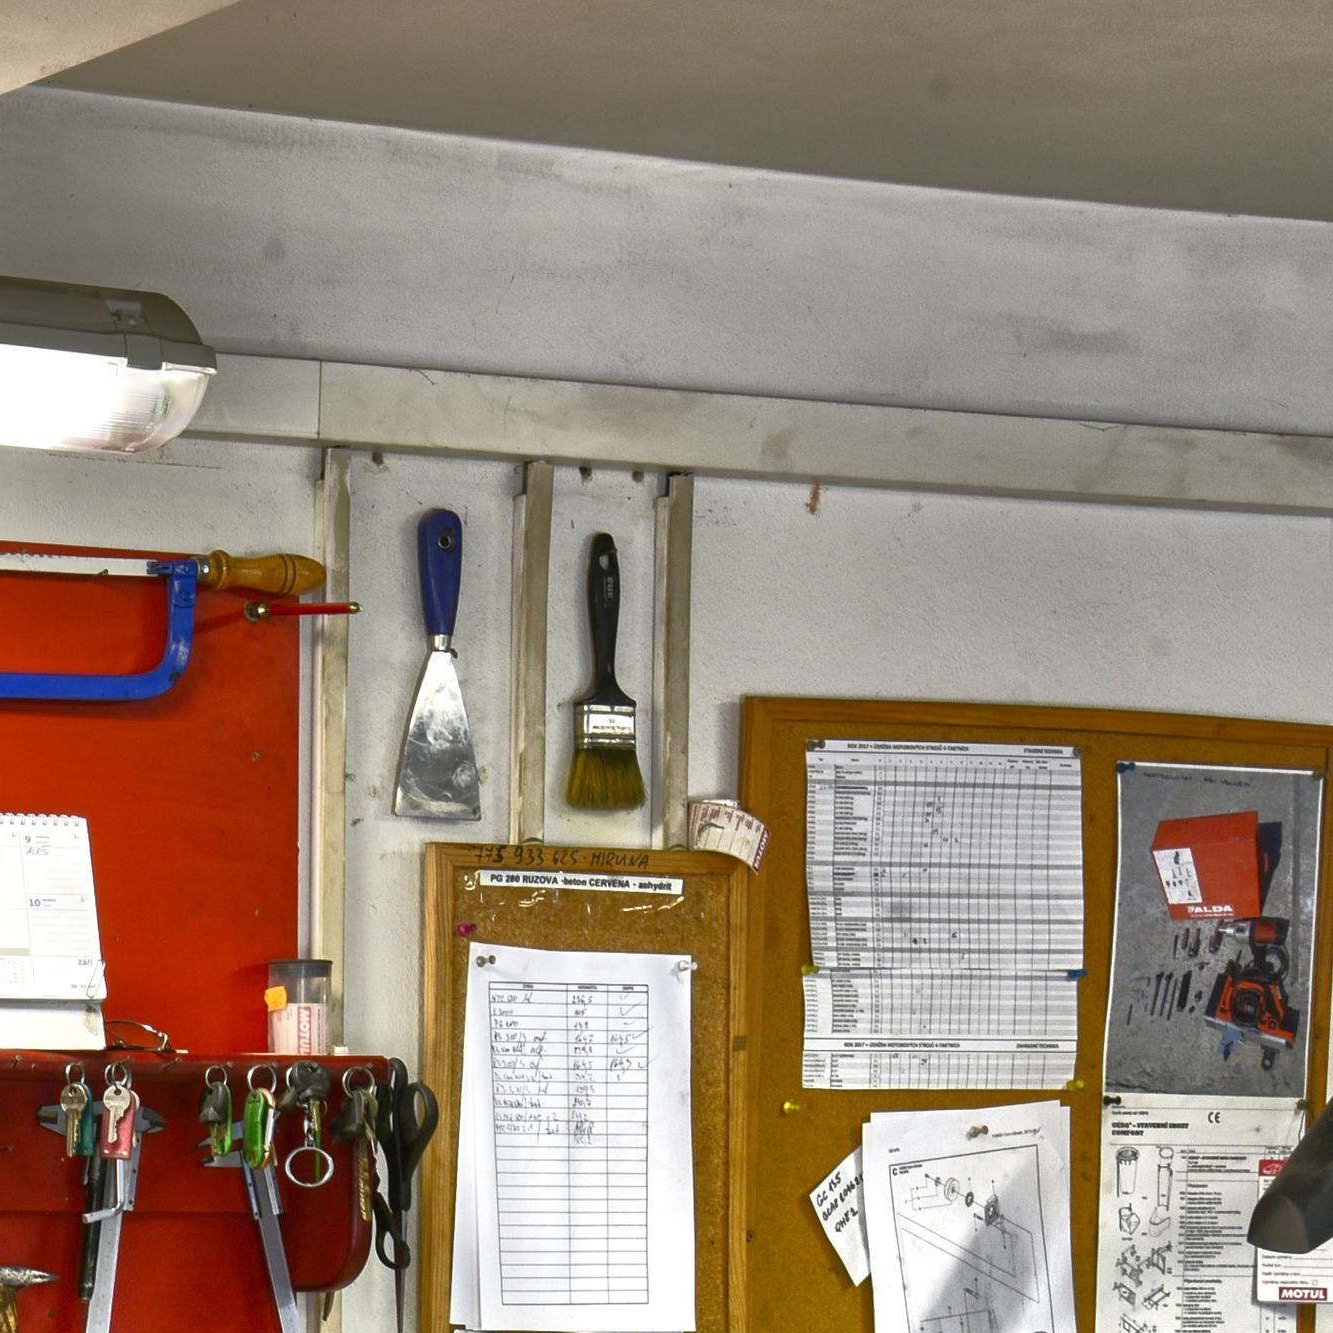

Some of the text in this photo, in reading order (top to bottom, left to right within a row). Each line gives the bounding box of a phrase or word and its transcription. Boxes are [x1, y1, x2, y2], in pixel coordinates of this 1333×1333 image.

[490, 873, 503, 883] PG
[28, 898, 41, 908] 10
[1280, 1289, 1325, 1299] MOTUL
